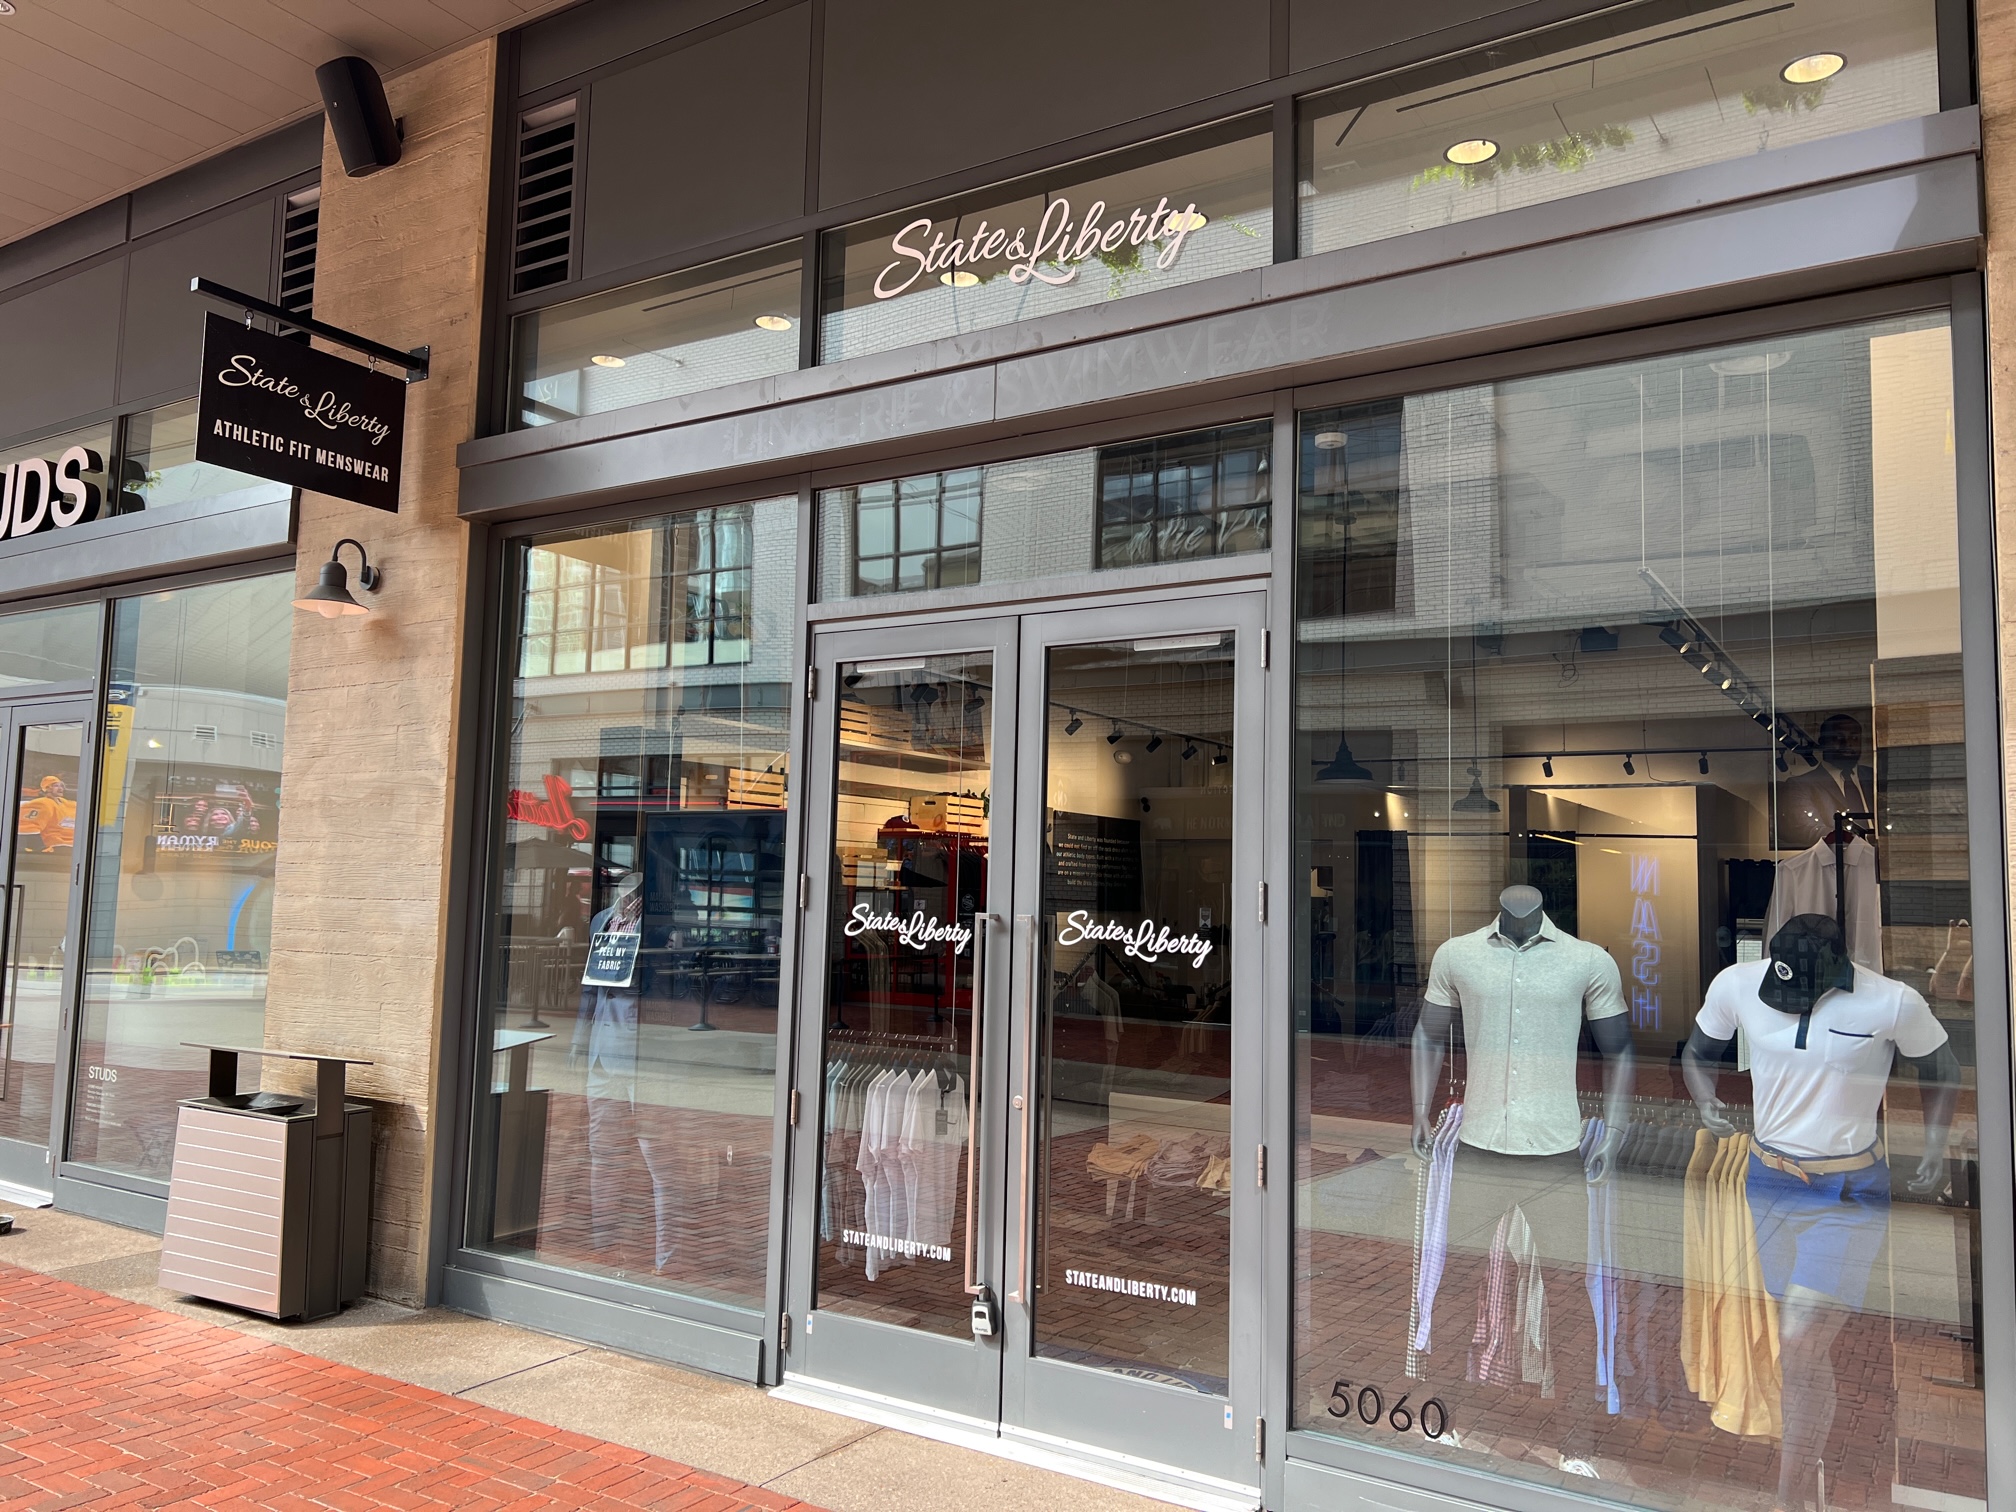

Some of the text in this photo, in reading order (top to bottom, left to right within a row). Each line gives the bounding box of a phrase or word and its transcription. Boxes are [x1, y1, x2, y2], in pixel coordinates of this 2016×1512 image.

[873, 197, 1198, 299] State & Liberty
[218, 354, 390, 446] State & Liberty
[213, 418, 390, 483] ATHLETIC FIT MENSWEAR
[598, 946, 627, 957] FEEL MY
[845, 903, 972, 955] State & Liberty
[1059, 910, 1213, 969] State & Liberty
[597, 960, 622, 971] FABRIC
[88, 1065, 118, 1083] STUDS
[843, 1229, 951, 1262] STATEANDLIBERTY.COM
[1065, 1269, 1196, 1306] STATEANDLIBERTY.COM
[1327, 1380, 1446, 1440] 5060
